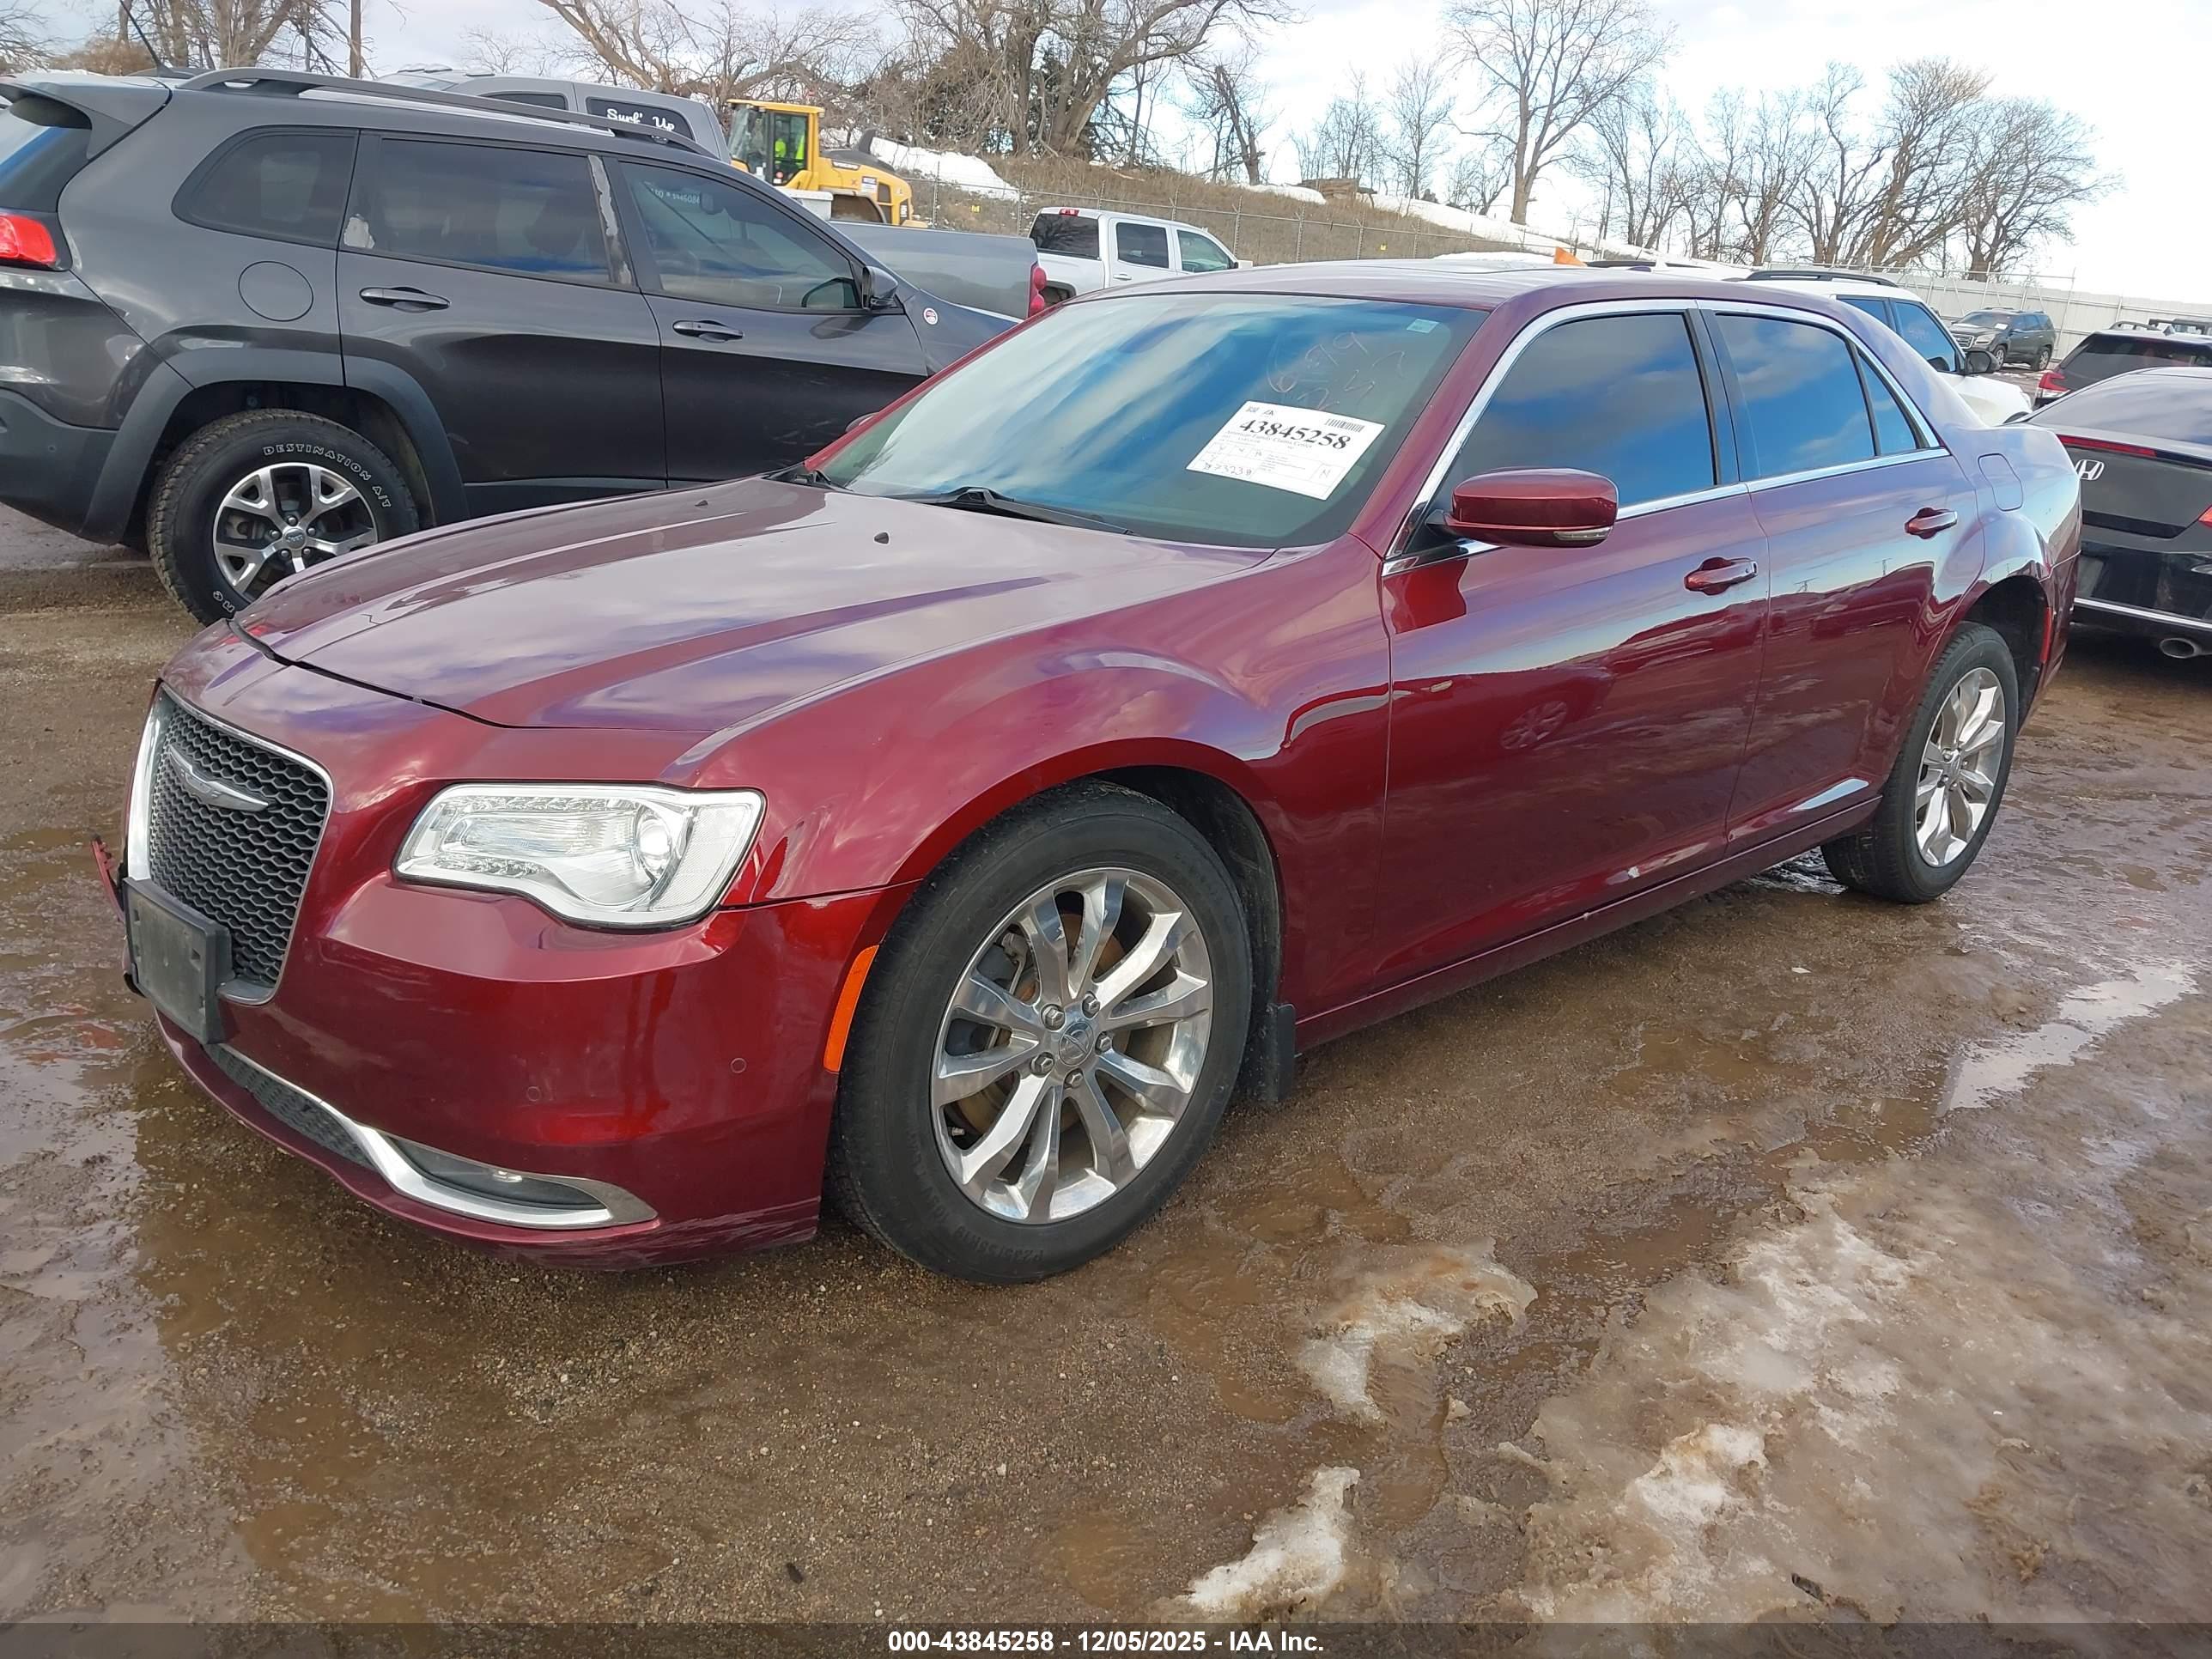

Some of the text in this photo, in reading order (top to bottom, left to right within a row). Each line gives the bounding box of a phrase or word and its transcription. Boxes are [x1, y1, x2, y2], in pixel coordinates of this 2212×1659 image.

[653, 116, 675, 132] Up
[1239, 419, 1351, 450] 43845258
[263, 443, 392, 508] DESTINATION A/T
